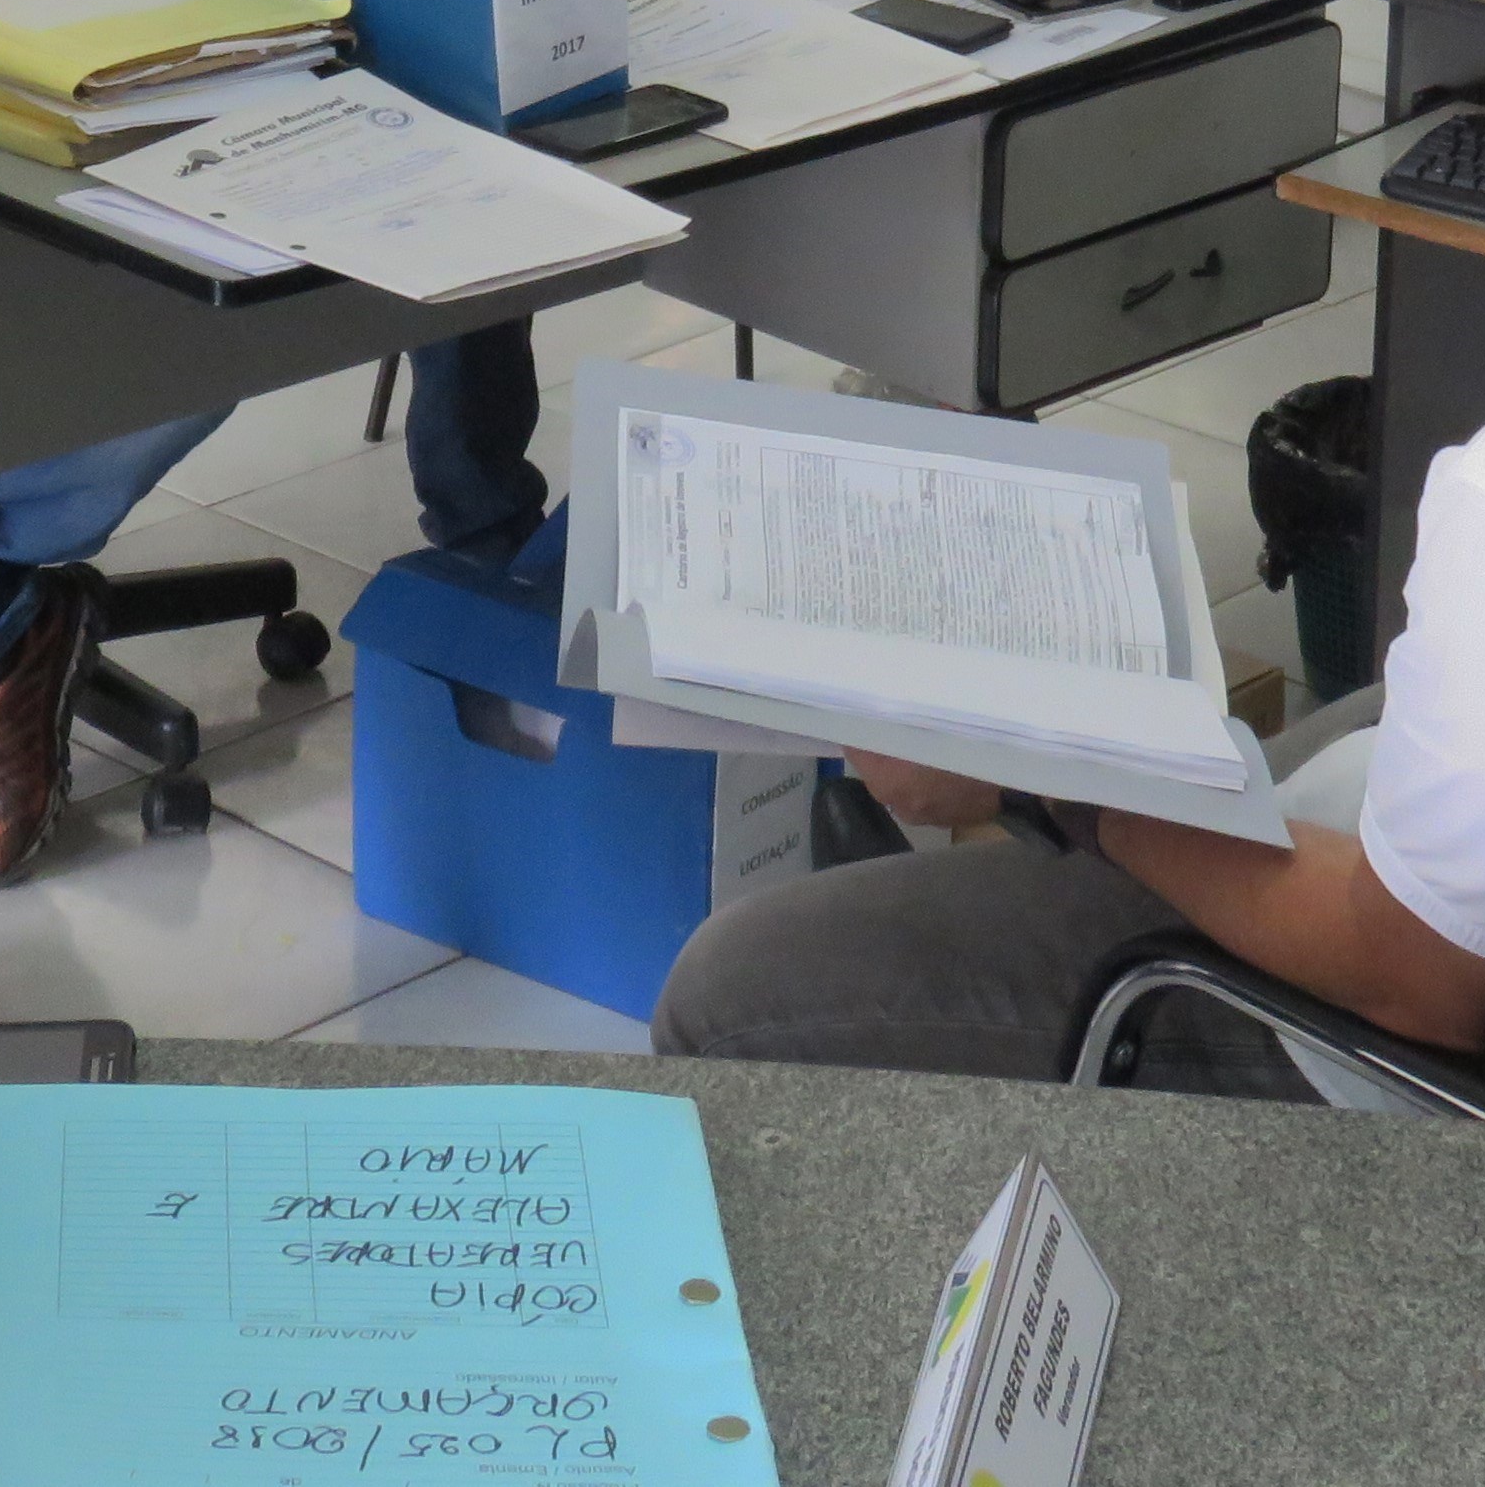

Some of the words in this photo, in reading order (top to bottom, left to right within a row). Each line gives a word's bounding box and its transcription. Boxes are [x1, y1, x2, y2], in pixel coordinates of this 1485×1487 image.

[552, 34, 586, 62] 2017
[277, 95, 348, 126] Municipal
[231, 147, 250, 158] de
[741, 771, 804, 815] COMISSÃO
[360, 1143, 549, 1186] MÁRIO
[145, 1192, 199, 1219] E
[262, 1194, 571, 1226] ALEXANDRE
[281, 1241, 589, 1268] VEREADORES
[430, 1280, 598, 1327] CÓPIA
[239, 1326, 418, 1341] ANDAMENTO
[993, 1332, 1031, 1444] ROBERTO
[1021, 1213, 1063, 1341] BELARMINO
[1032, 1299, 1071, 1419] FAGUNDES
[454, 1372, 556, 1385] Interessado
[574, 1374, 619, 1386] Autor
[220, 1384, 609, 1421] ORÇAMENTO
[526, 1426, 618, 1460] PL
[478, 1464, 548, 1476] Ementa
[561, 1465, 637, 1477] Assunto
